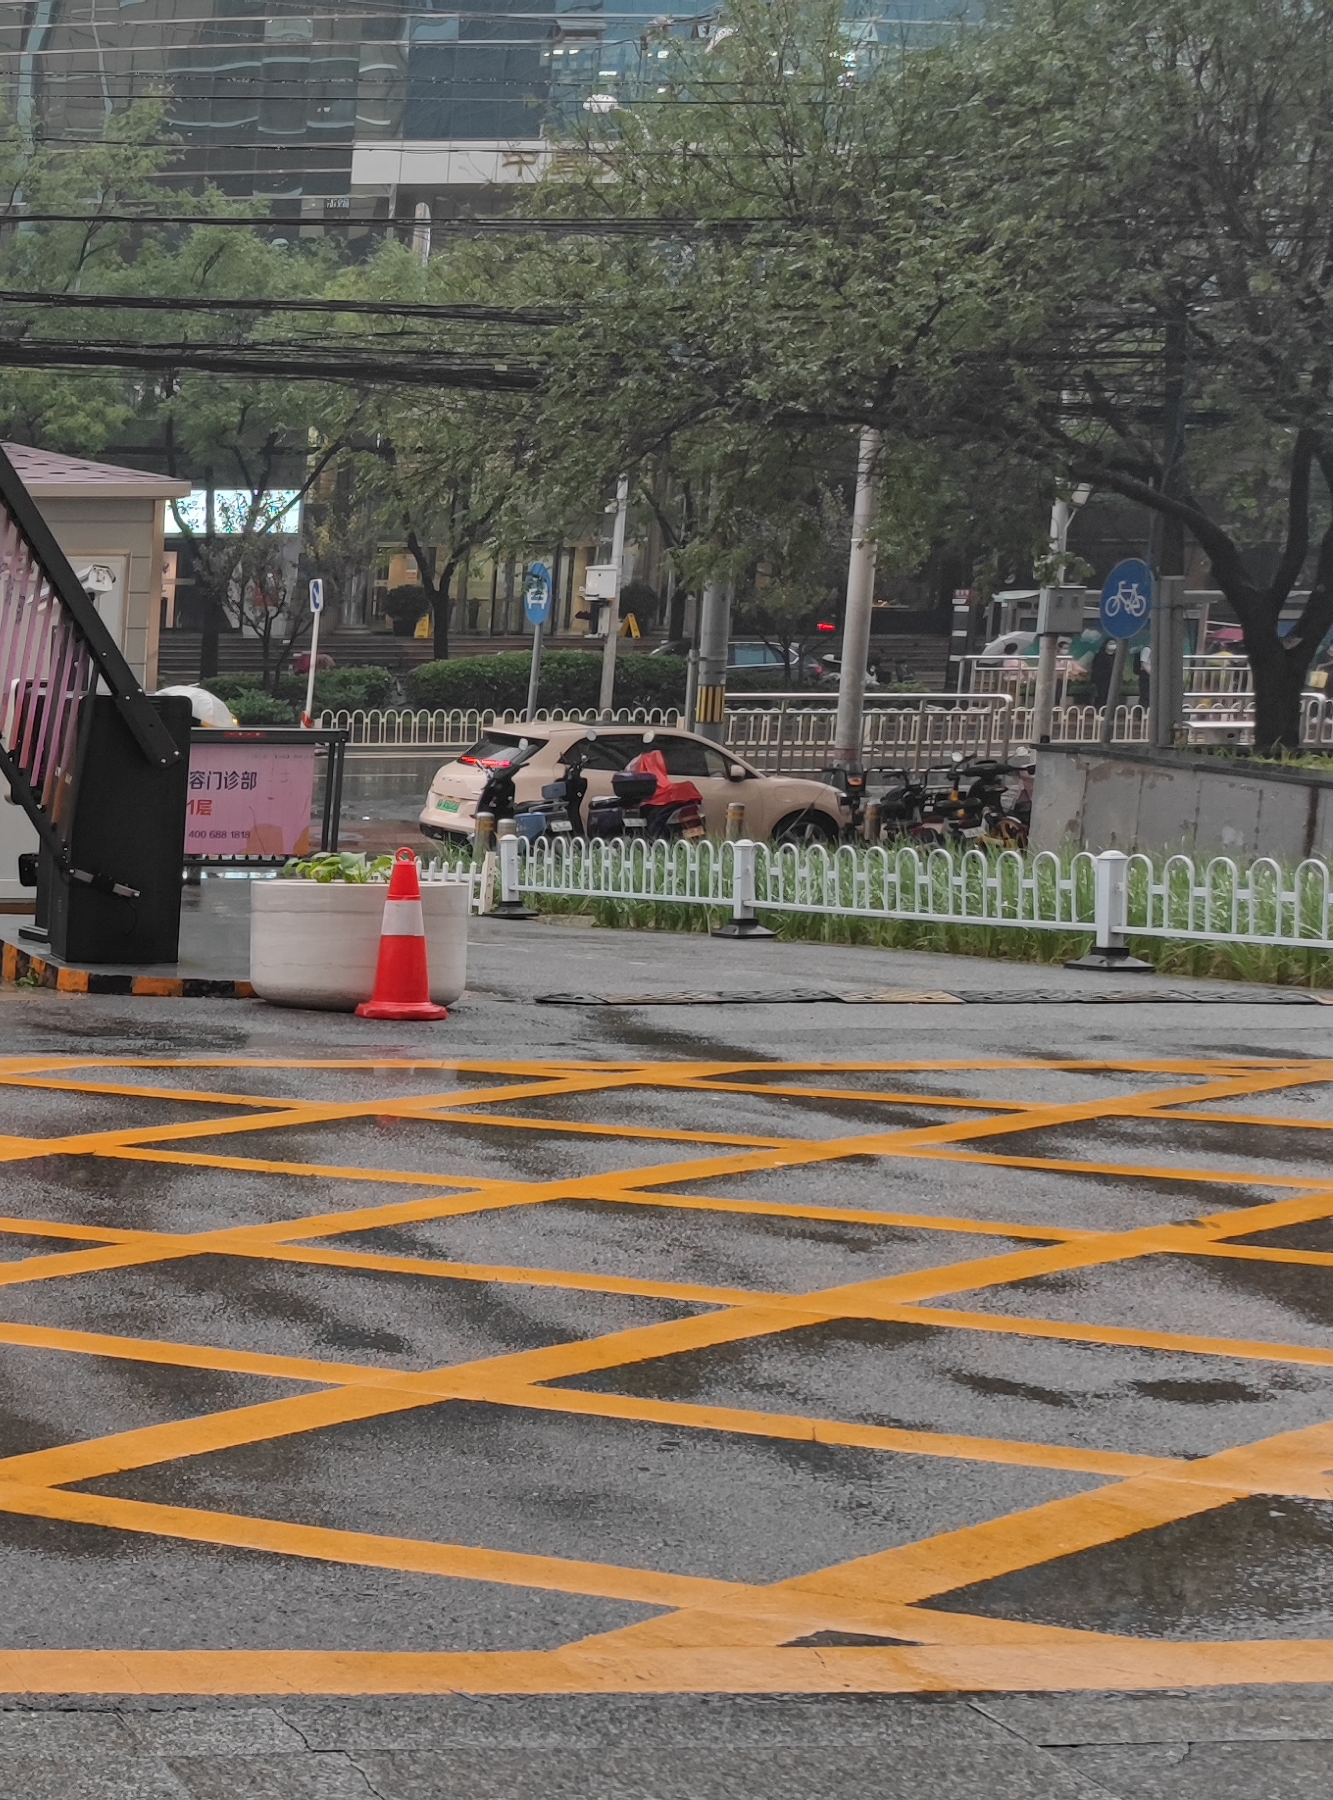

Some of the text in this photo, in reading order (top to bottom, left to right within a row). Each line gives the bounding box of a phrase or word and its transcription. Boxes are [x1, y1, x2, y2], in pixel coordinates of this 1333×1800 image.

[189, 770, 257, 790] 容门诊部
[187, 799, 213, 816] 1层
[188, 830, 207, 839] 400
[231, 830, 251, 839] 1818
